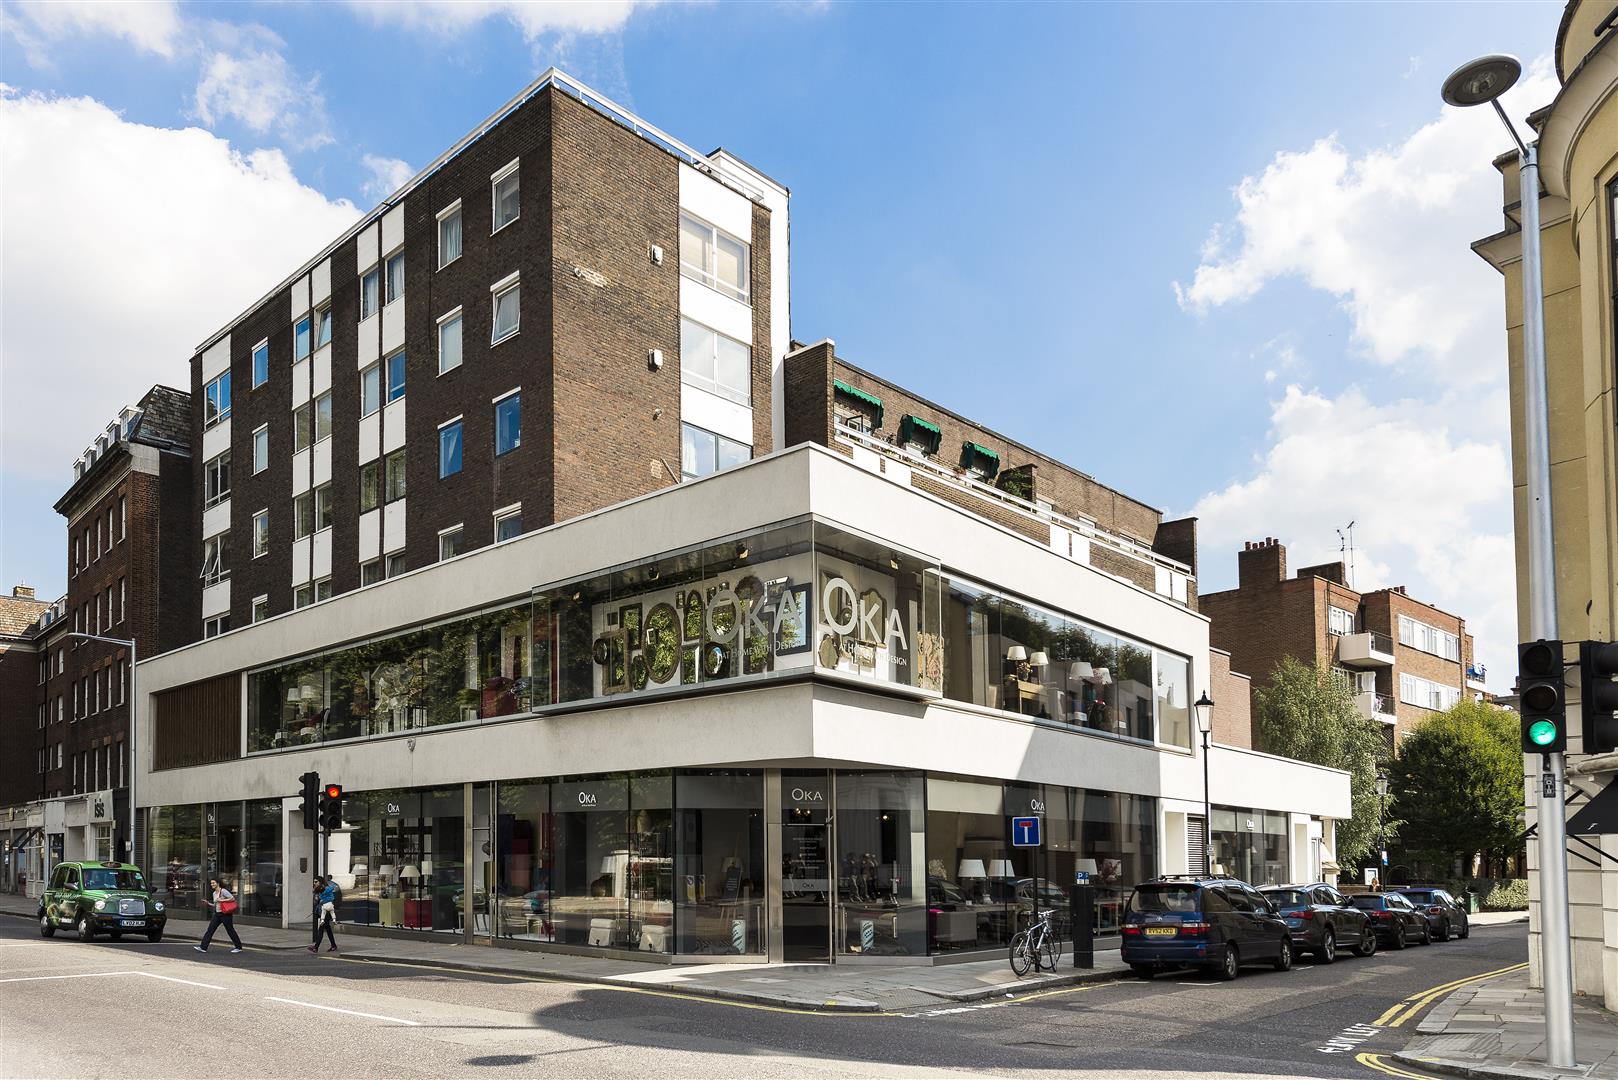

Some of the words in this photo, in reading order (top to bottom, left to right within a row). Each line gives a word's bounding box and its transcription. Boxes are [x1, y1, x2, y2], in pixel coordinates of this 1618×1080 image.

[706, 589, 801, 644] OKA
[823, 577, 908, 650] OKA
[578, 791, 597, 804] OKA
[791, 788, 823, 801] OKA
[387, 803, 400, 813] OKA
[1030, 798, 1045, 811] OKA
